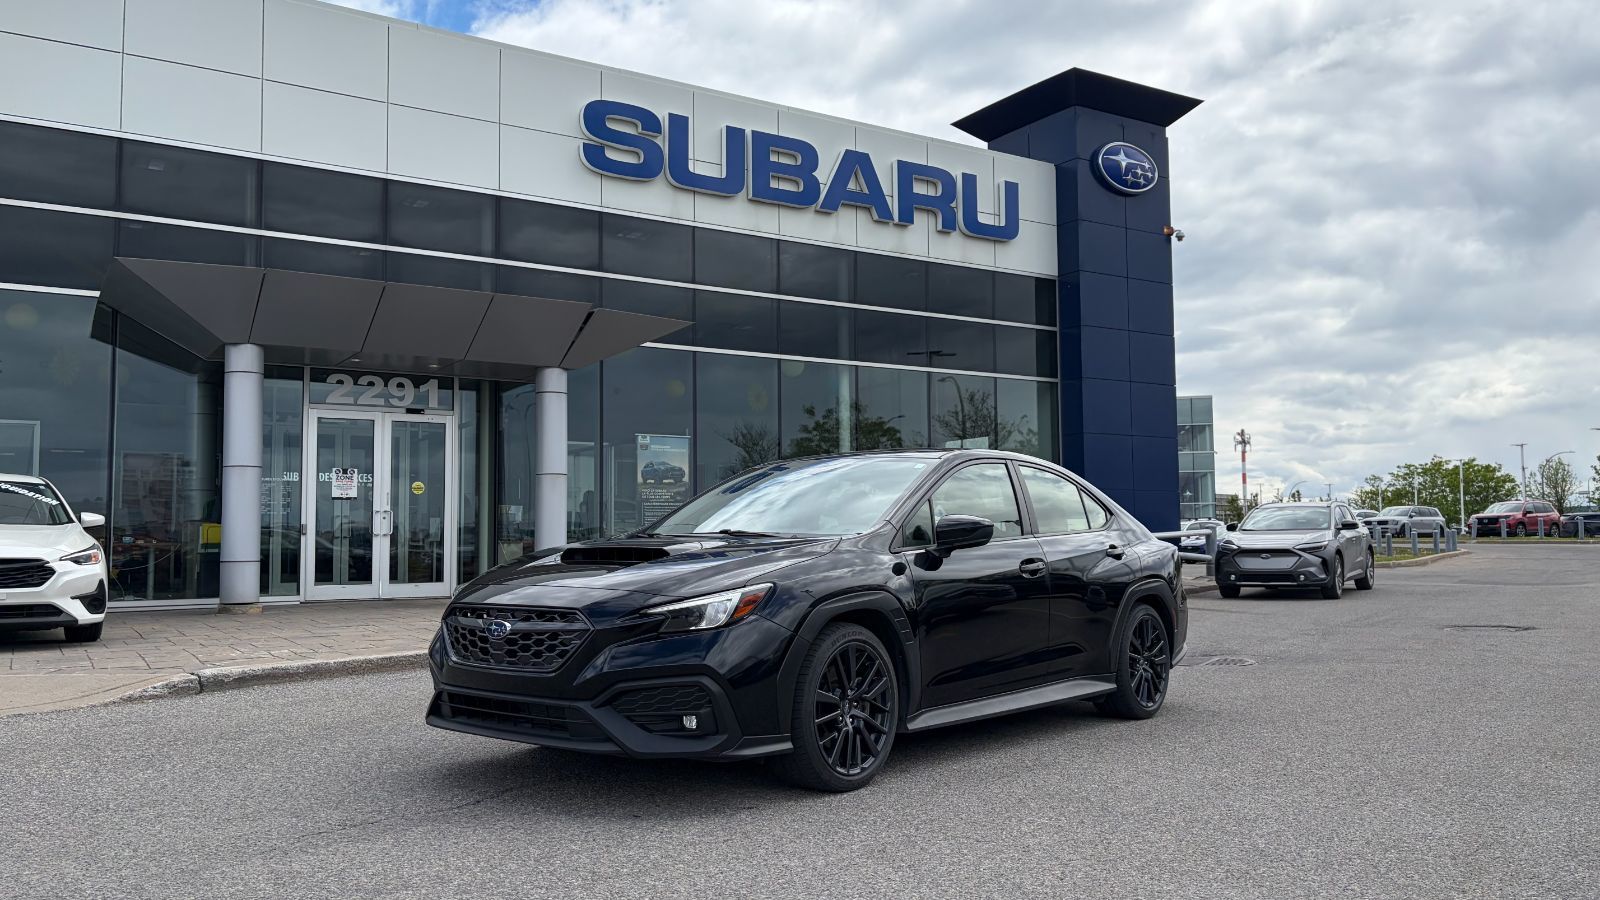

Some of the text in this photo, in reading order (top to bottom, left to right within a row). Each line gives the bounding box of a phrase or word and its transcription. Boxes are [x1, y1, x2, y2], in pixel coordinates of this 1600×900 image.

[579, 99, 1019, 241] SUBARU
[326, 373, 438, 408] 2291
[0, 483, 60, 505] IQUIDATION
